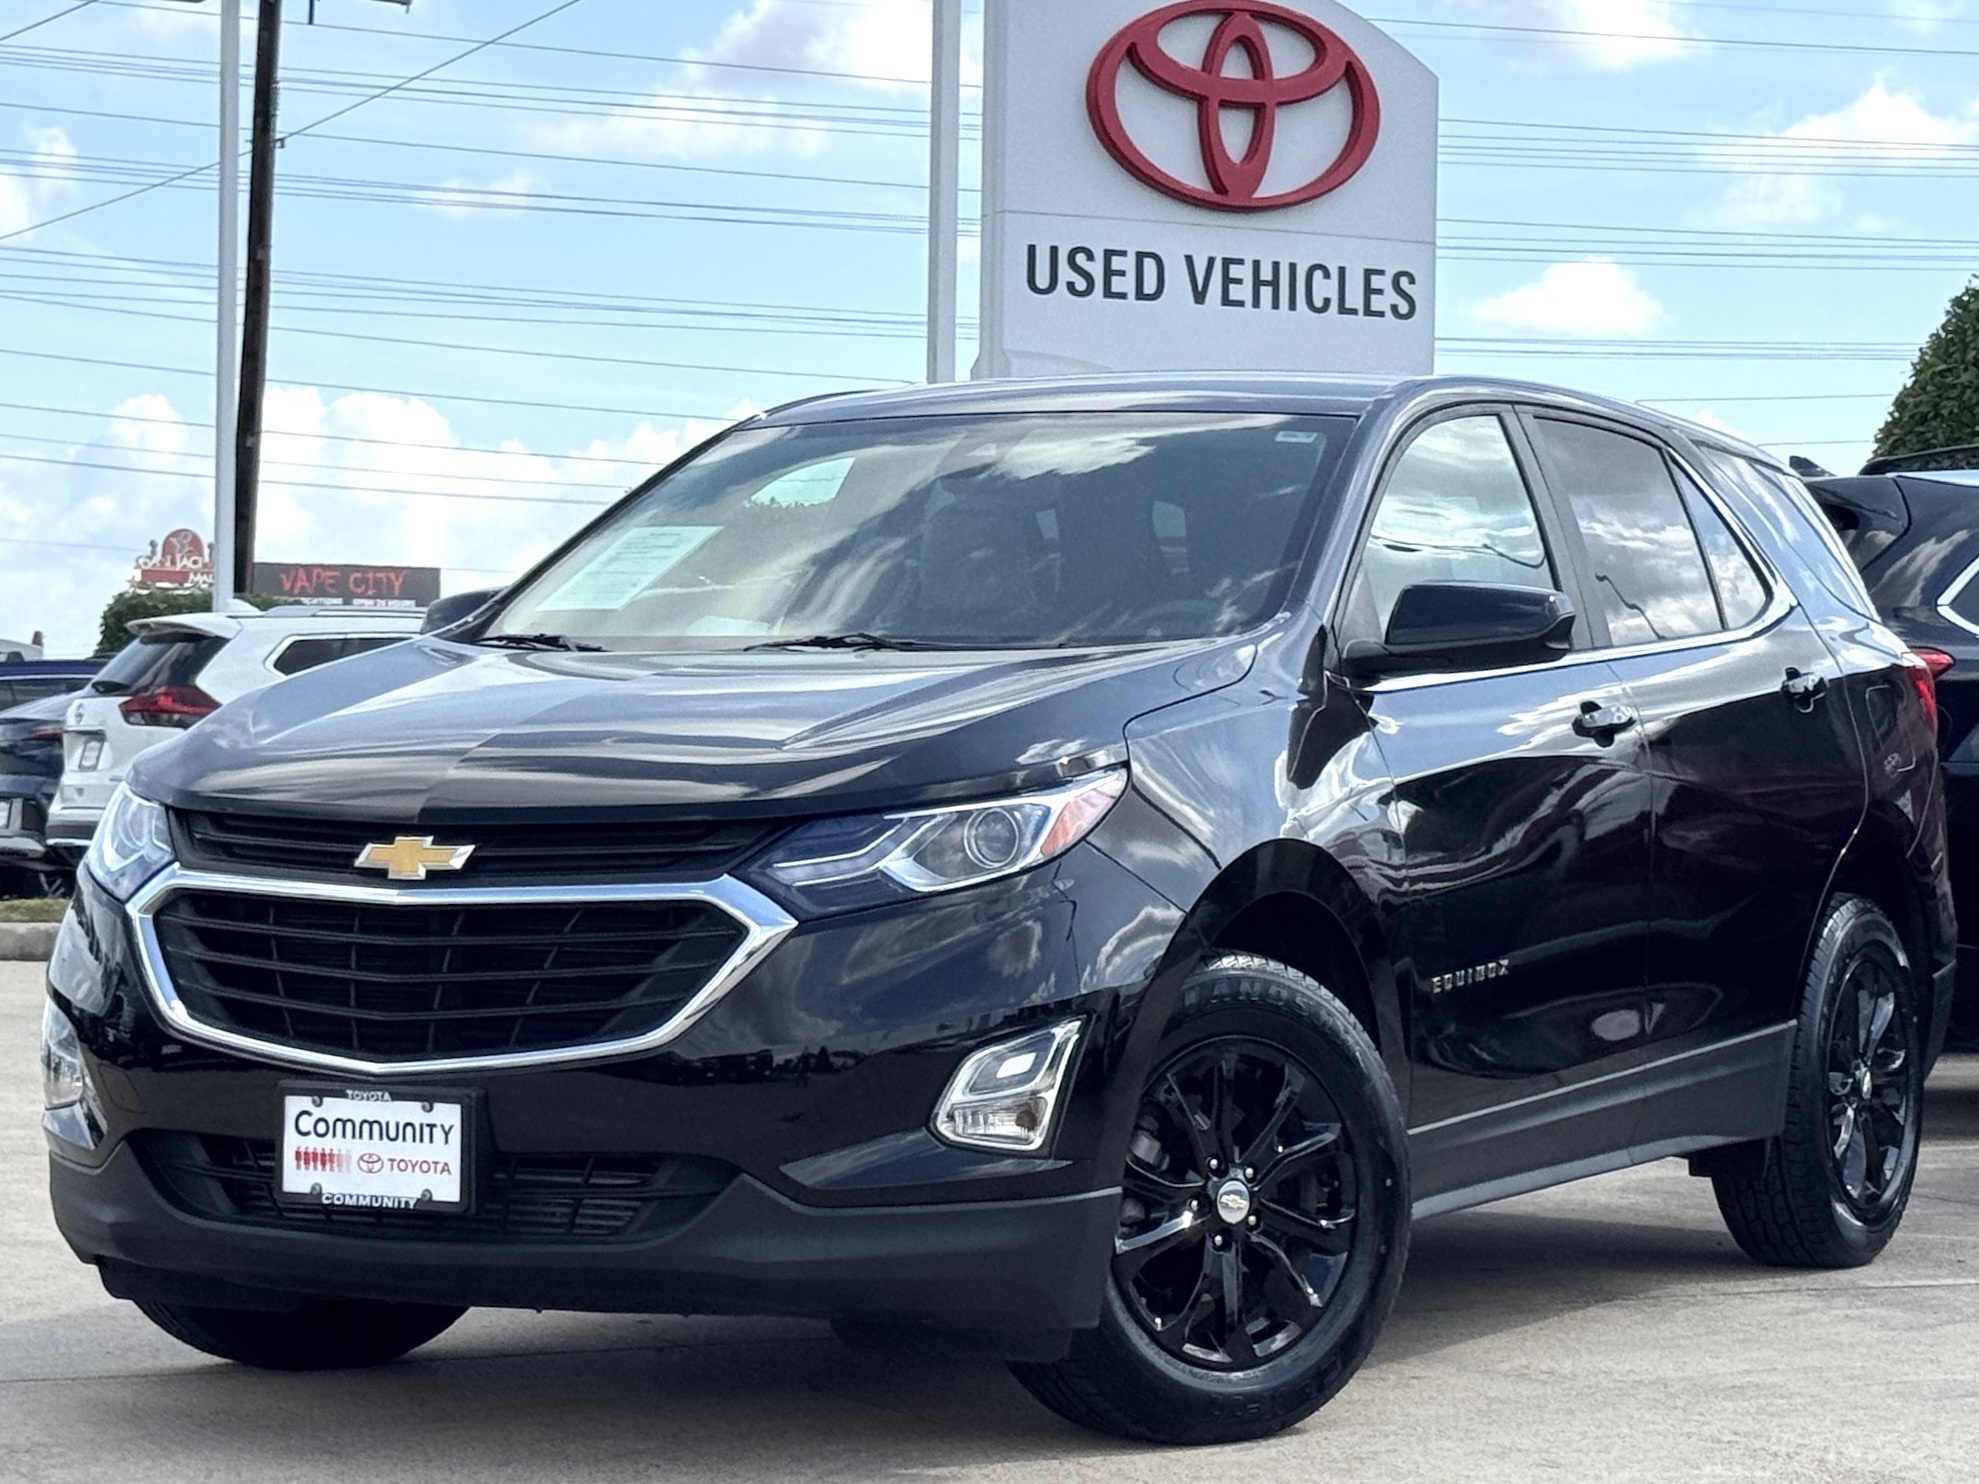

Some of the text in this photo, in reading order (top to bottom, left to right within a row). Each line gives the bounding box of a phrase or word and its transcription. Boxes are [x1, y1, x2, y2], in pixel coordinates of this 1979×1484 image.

[1027, 244, 1417, 321] USED VEHICLES
[280, 567, 407, 596] VAPE CITY
[1431, 959, 1509, 994] EQUINOX
[346, 1089, 392, 1102] TOYOTA
[387, 1158, 453, 1176] TOYOTA
[321, 1192, 418, 1210] COMMUNITY
